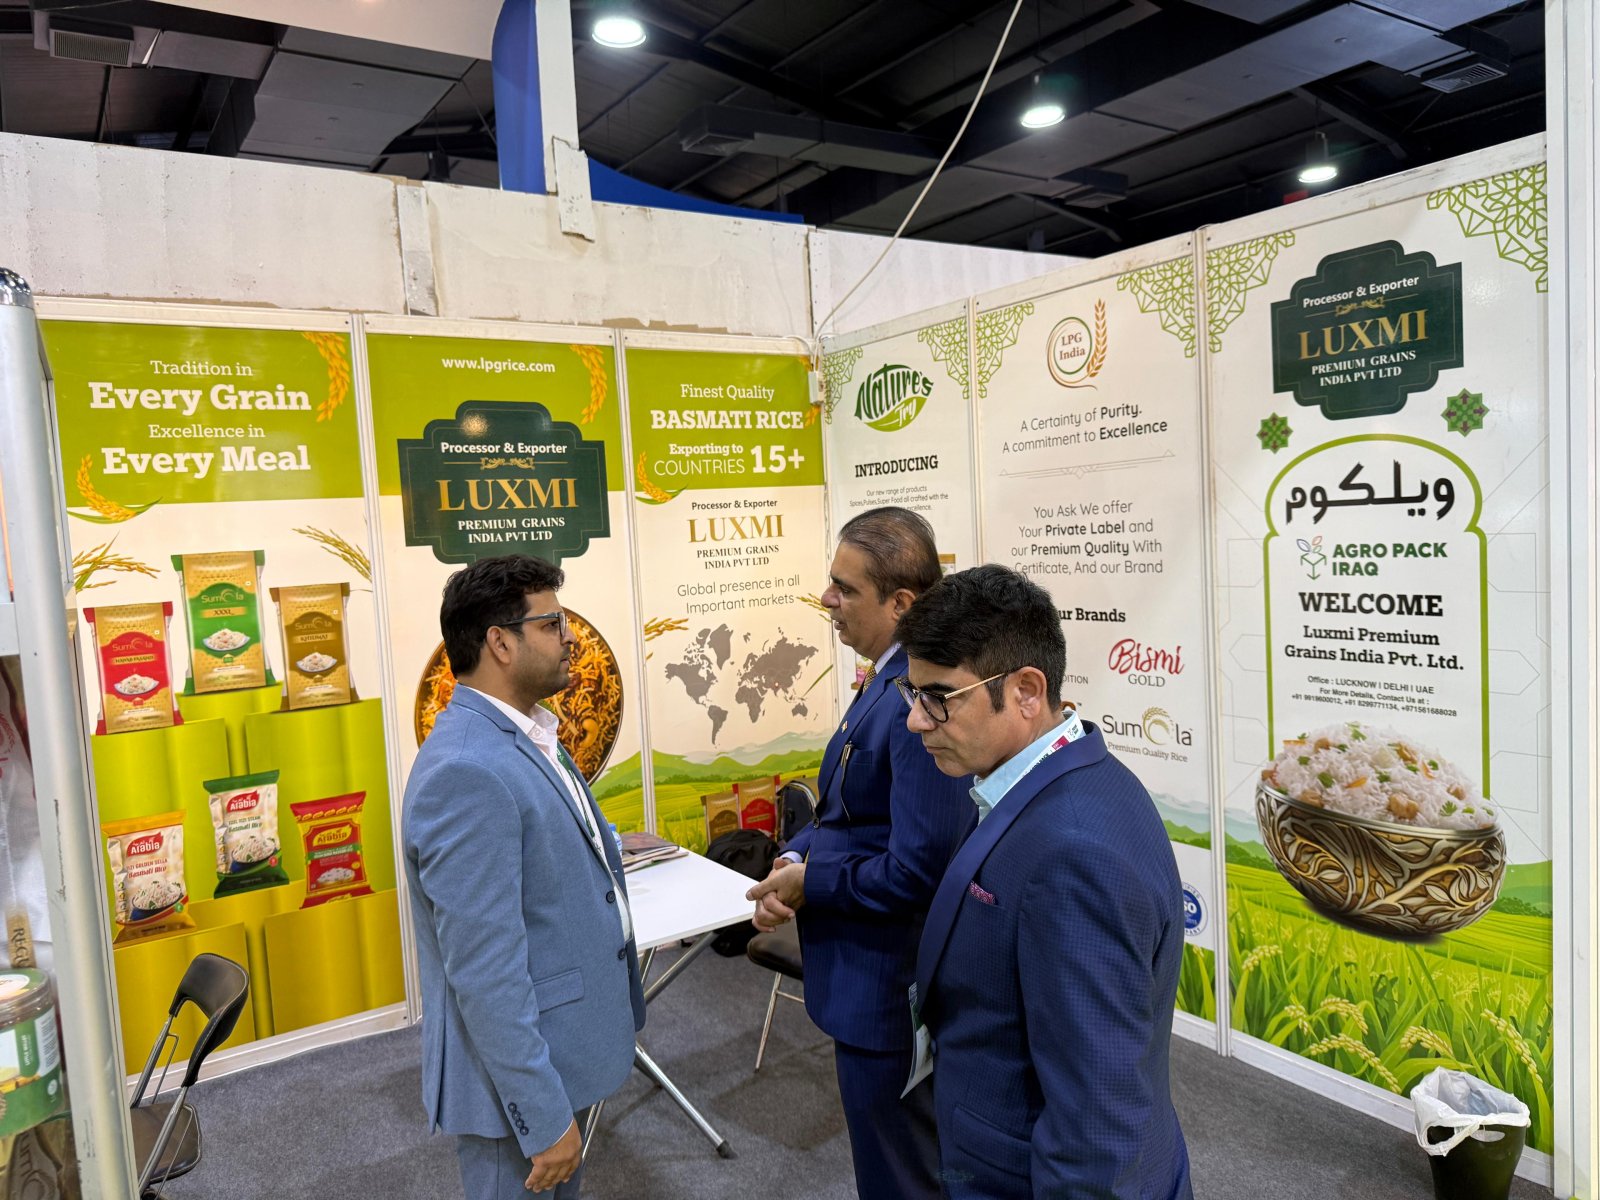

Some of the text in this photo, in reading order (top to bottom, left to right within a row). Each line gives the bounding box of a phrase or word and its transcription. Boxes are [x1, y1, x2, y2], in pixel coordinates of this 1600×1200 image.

[1303, 276, 1419, 309] Processor & Exporter
[1061, 332, 1083, 346] LPG
[1298, 309, 1429, 361] LUXMI
[1059, 347, 1086, 361] India
[1312, 350, 1416, 375] PREMIUM GRAINS
[150, 360, 253, 376] Tradition in
[441, 357, 556, 373] www.lpgrice.com
[1320, 366, 1402, 387] INDIA PVT LTD
[88, 382, 312, 415] Every Grain
[681, 384, 775, 402] Finest Quality
[650, 410, 804, 430] BASMATI RICE
[895, 398, 917, 427] Try
[1020, 402, 1143, 432] A Certainty of Purity.
[148, 424, 265, 438] Excellence in
[1002, 420, 1168, 454] A commitment to Excellence
[441, 442, 567, 456] Processor & Exporter
[669, 444, 743, 457] Exporting to
[101, 445, 311, 479] Every Meal
[654, 459, 746, 476] COUNTRIES
[750, 445, 805, 473] 15+
[855, 454, 939, 478] INTRODUCING
[435, 478, 579, 511] LUXMI
[866, 489, 875, 497] Our
[886, 488, 899, 496] range
[906, 486, 927, 494] products
[910, 494, 928, 502] crafted
[1286, 459, 1455, 525] ويلكوم
[691, 500, 778, 510] Processor & Exporter
[1033, 500, 1133, 519] You Ask We offer
[458, 517, 565, 531] PREMIUM GRAINS
[686, 514, 785, 543] LUXMI
[1019, 518, 1154, 538] Your Private Label and
[468, 530, 553, 544] INDIA PVT LTD
[697, 544, 780, 558] PREMIUM GRAINS
[1011, 539, 1162, 557] our Premium Quality With
[1332, 542, 1448, 558] AGRO PACK
[704, 556, 770, 569] INDIA PVT LTD
[1015, 560, 1163, 575] Certificate, And our Brand
[1332, 561, 1379, 576] IRAQ
[677, 574, 800, 597] Global presence in all
[686, 594, 795, 615] Important markets
[1298, 591, 1444, 617] WELCOME
[1058, 608, 1126, 622] ur Brands
[1303, 625, 1440, 646] Luxmi Premium
[1108, 638, 1185, 675] Bismi
[1284, 645, 1465, 671] Grains India Pvt. Ltd.
[1128, 674, 1166, 688] GOLD
[1307, 675, 1330, 684] Office
[1335, 678, 1377, 689] LUCKNOW
[1383, 682, 1409, 692] DELHI
[1415, 685, 1435, 695] UAE
[1319, 687, 1330, 695] For
[1332, 689, 1348, 697] More
[1350, 691, 1375, 700] Details,
[1377, 693, 1404, 702] Contact
[1108, 742, 1188, 763] Premium Quality Rice
